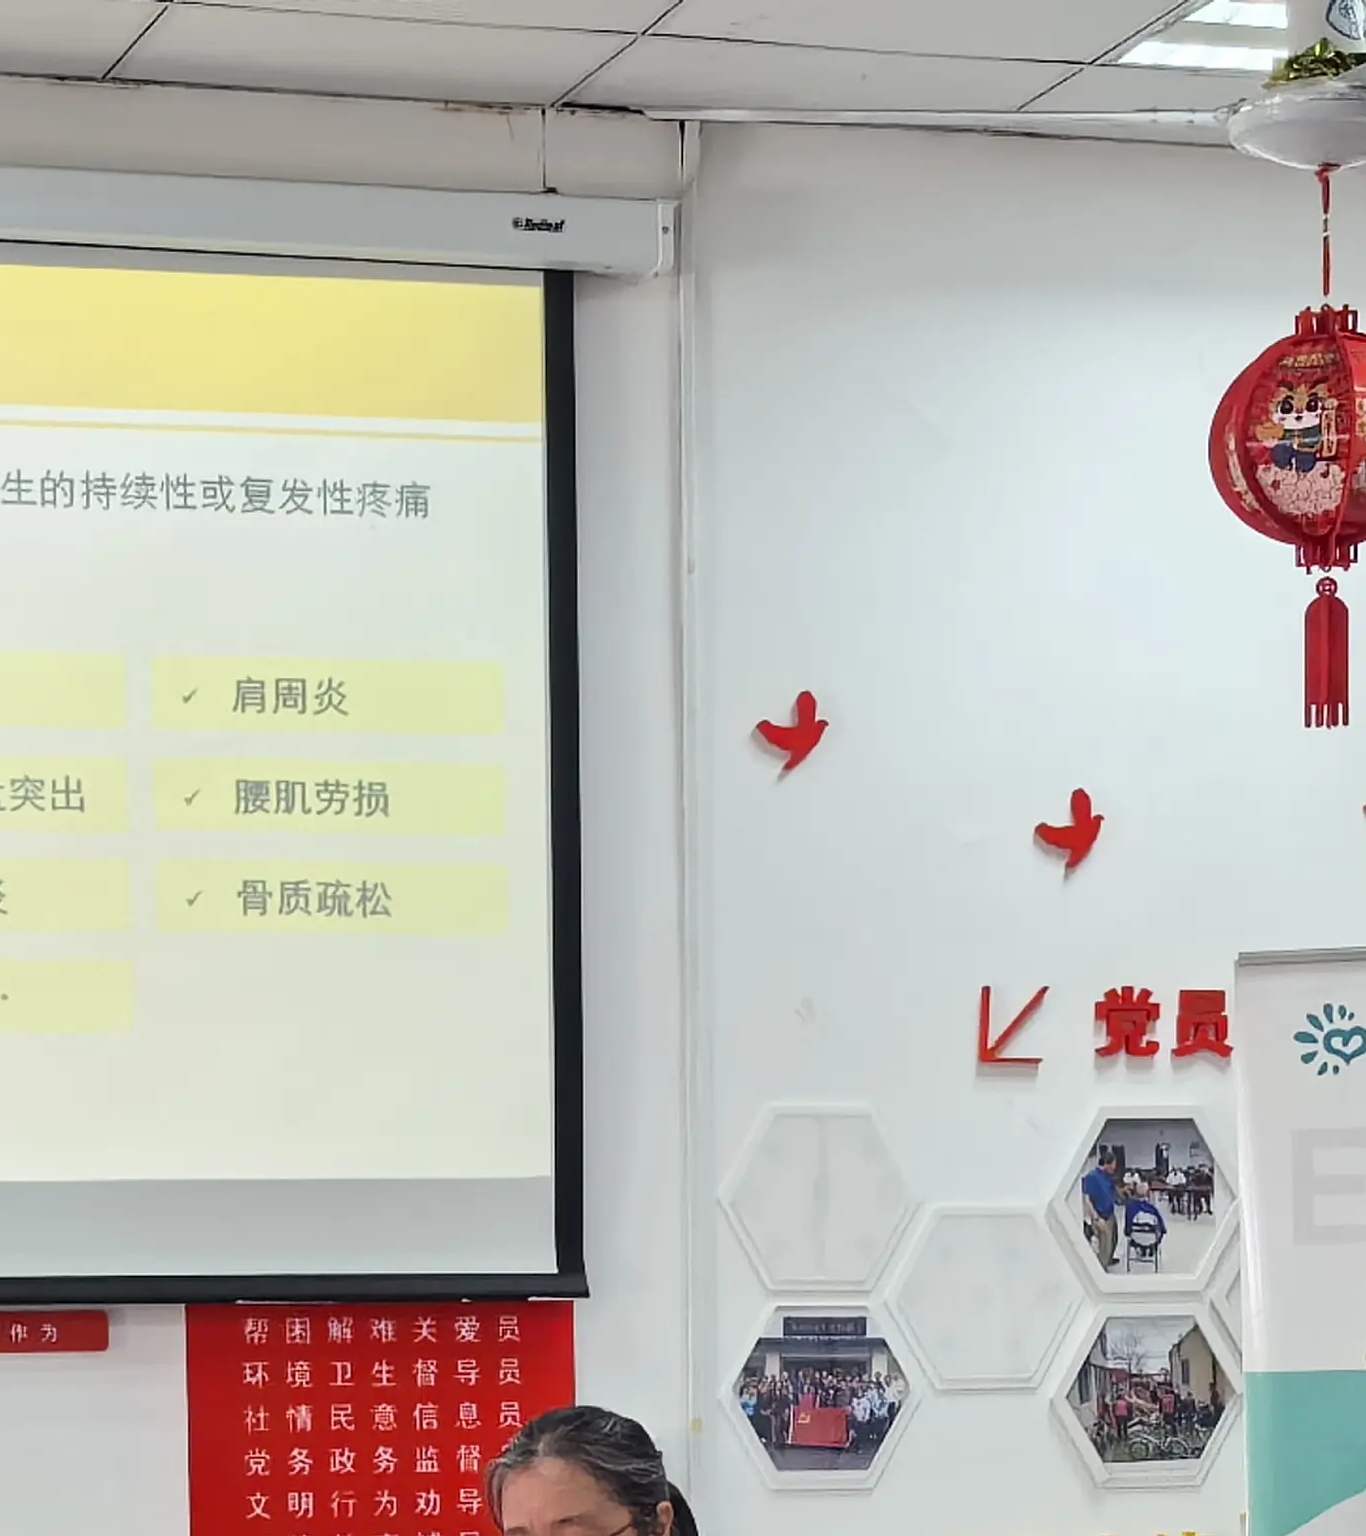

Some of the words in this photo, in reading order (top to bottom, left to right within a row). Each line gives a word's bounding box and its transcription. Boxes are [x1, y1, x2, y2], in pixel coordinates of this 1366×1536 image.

[232, 676, 350, 718] 肩周炎
[233, 778, 390, 819] 腰肌劳损
[236, 878, 393, 920] 骨质疏松
[243, 1315, 522, 1346] 帮困解难关爱员
[242, 1357, 522, 1389] 环境卫生督导员
[243, 1400, 524, 1434] 社情民意信息员
[244, 1443, 485, 1477] 党务政务监督
[245, 1488, 483, 1520] 文明行为劝导
